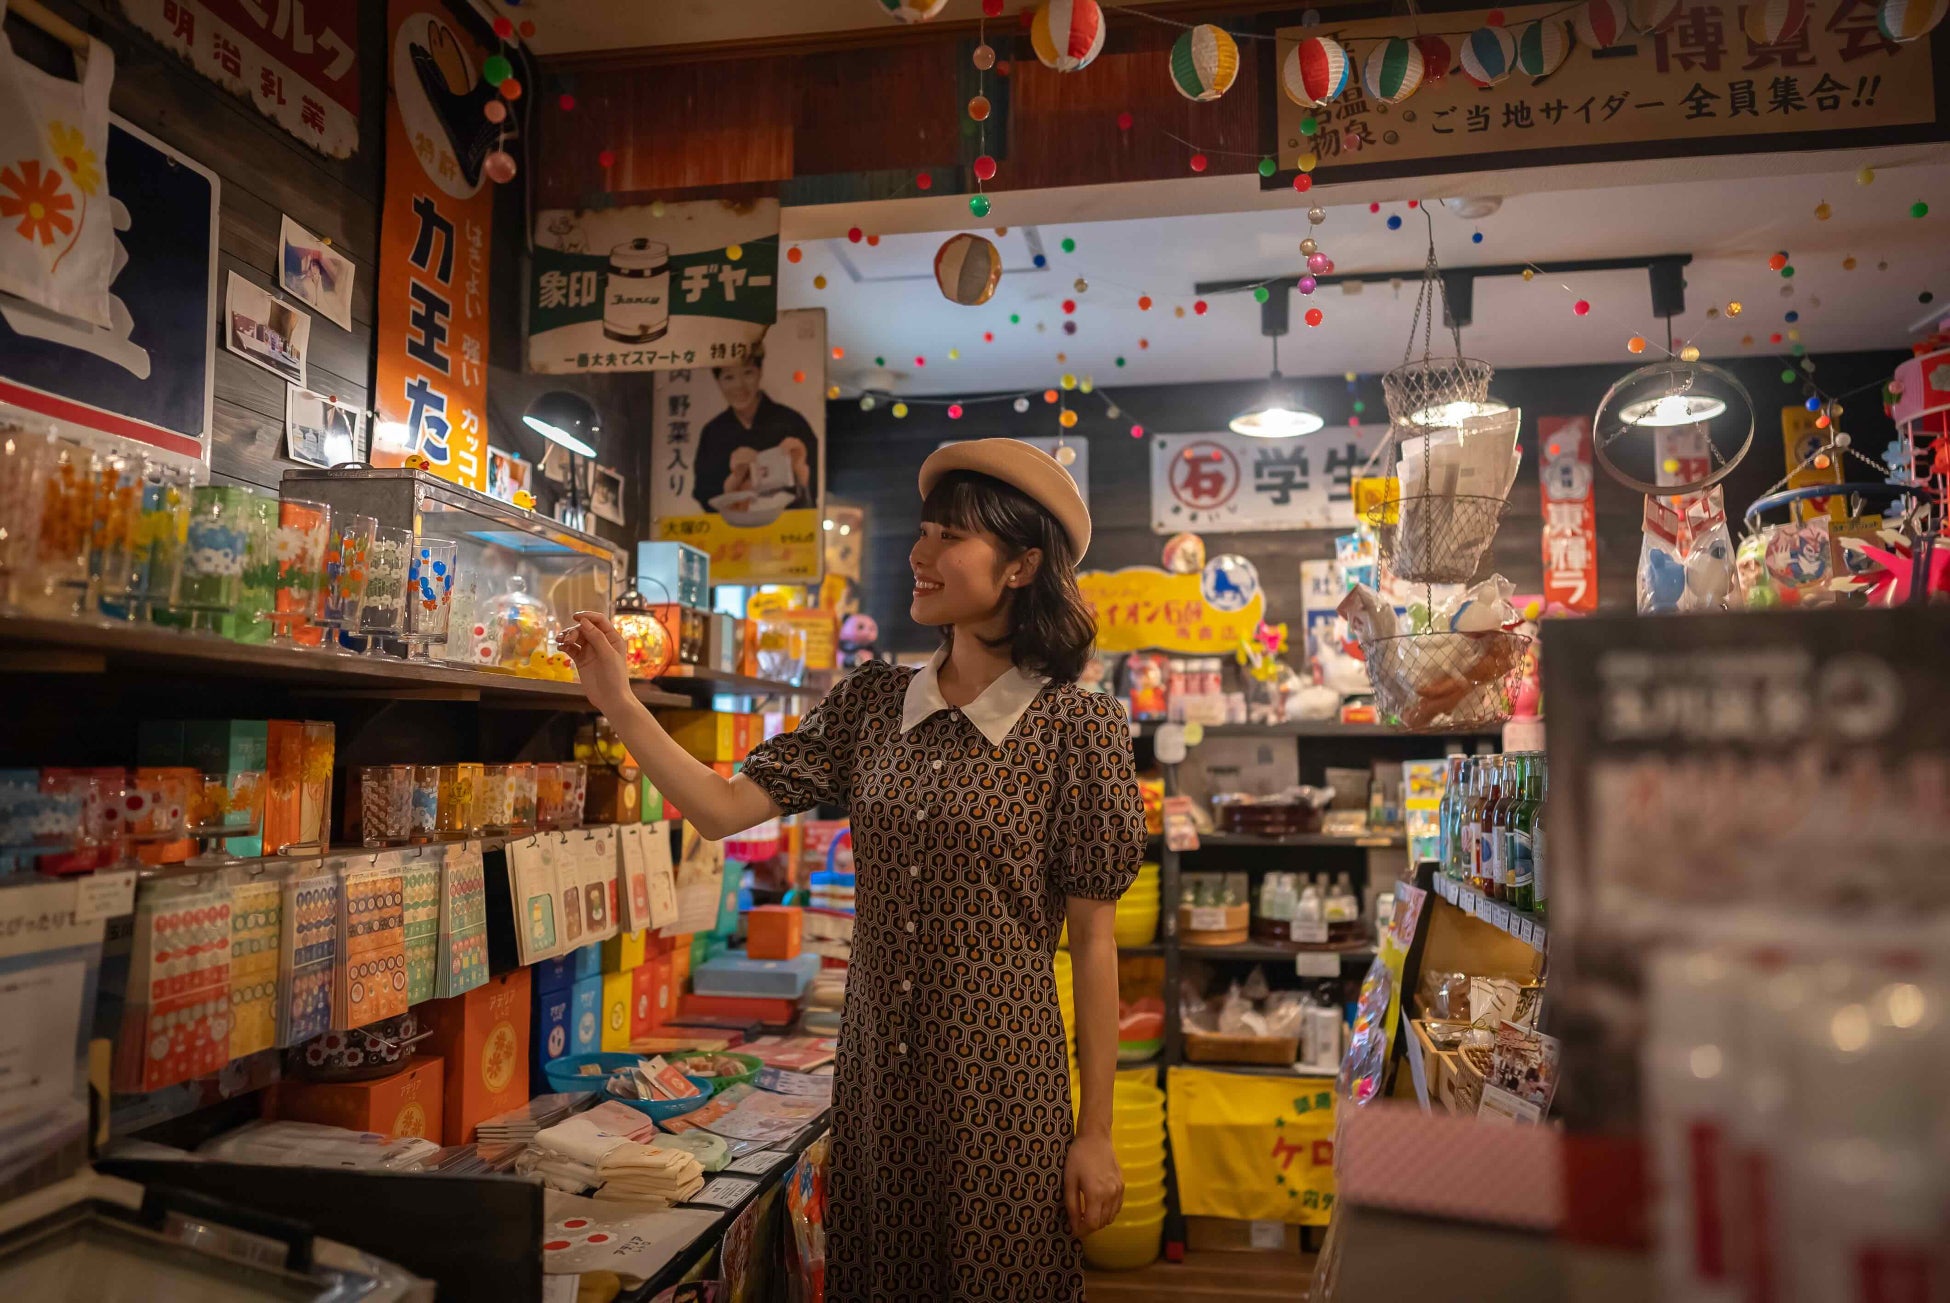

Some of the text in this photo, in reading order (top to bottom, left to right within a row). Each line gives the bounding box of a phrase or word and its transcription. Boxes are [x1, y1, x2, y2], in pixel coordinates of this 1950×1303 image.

[162, 0, 327, 136] 明治乳業
[538, 270, 598, 309] 象印
[563, 349, 696, 368] 一番丈夫でスマートな
